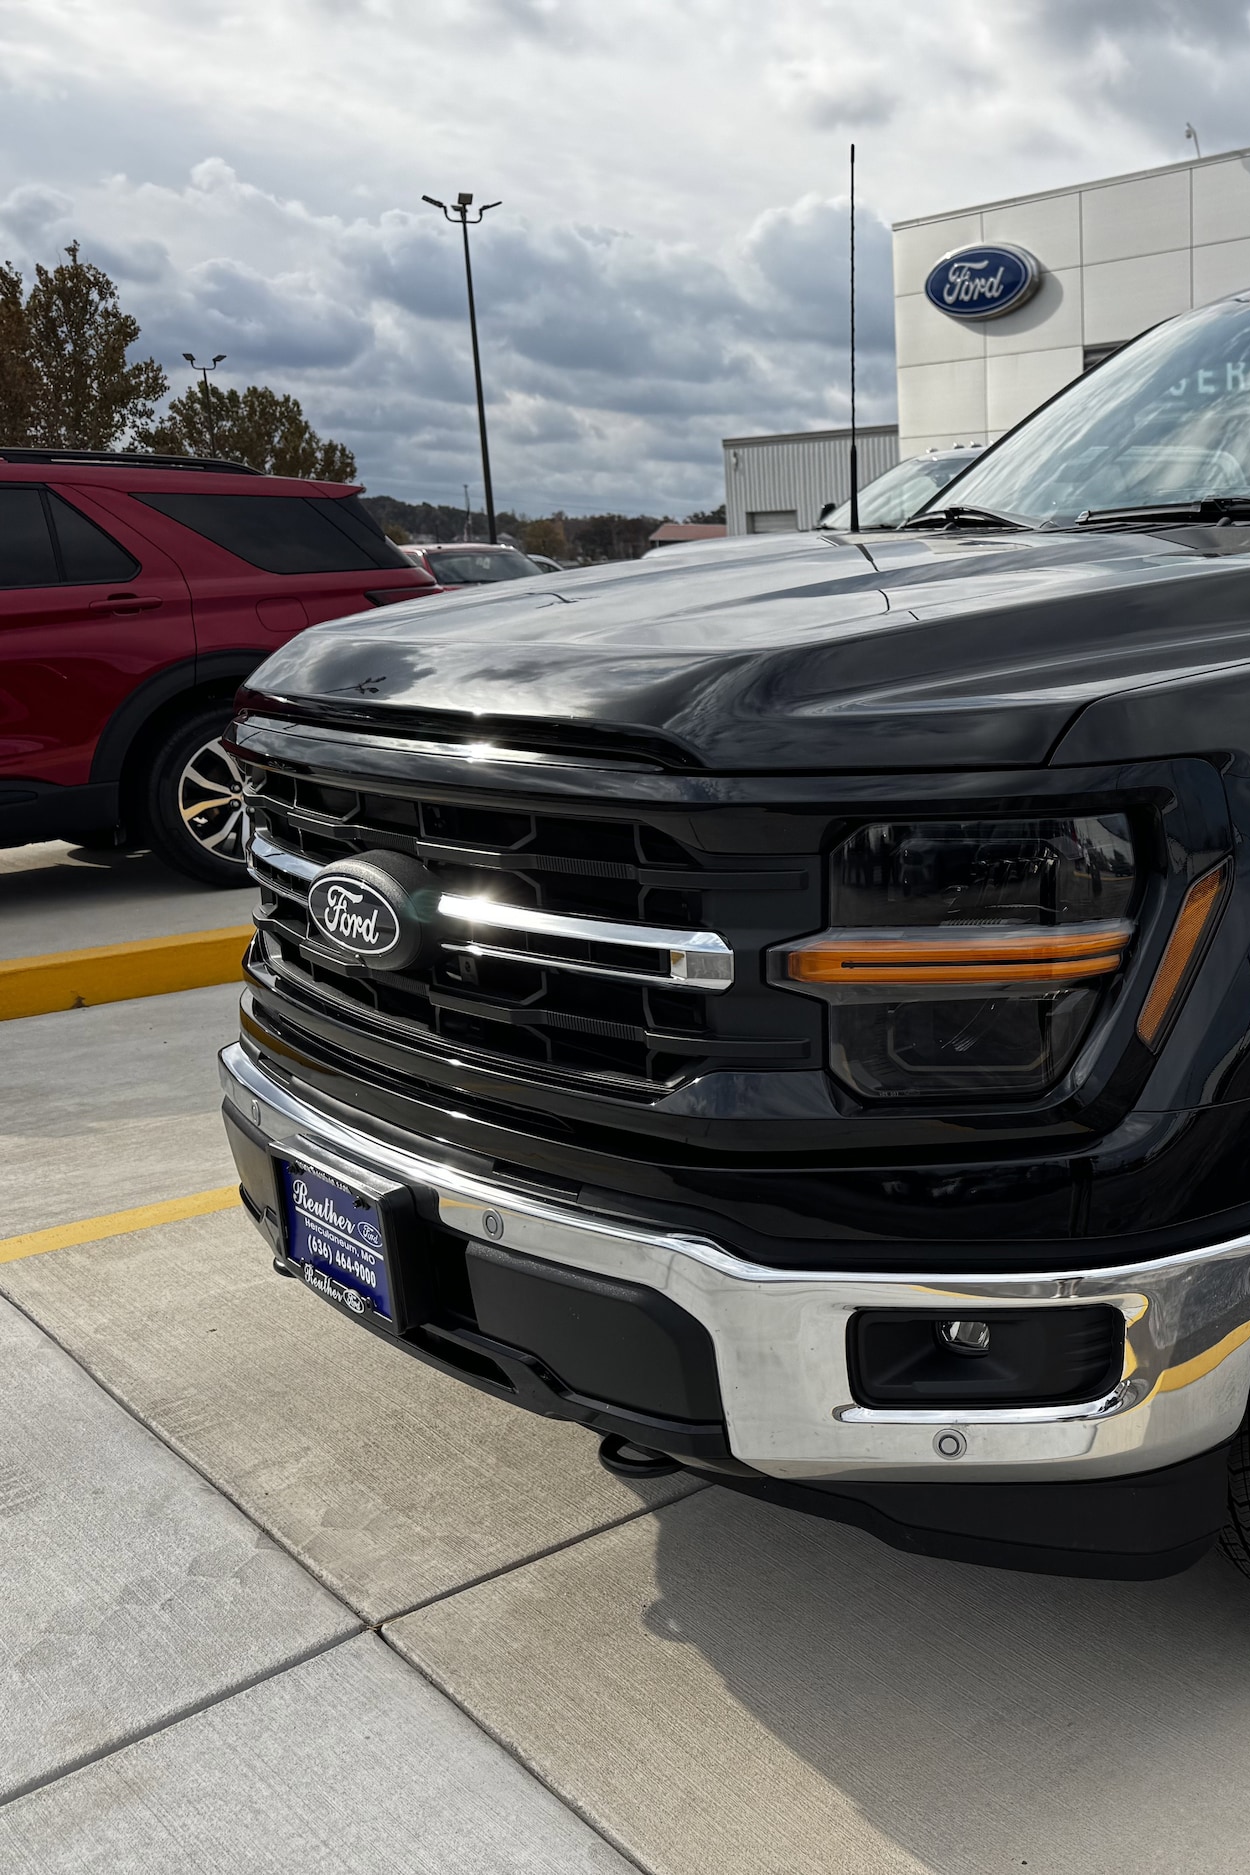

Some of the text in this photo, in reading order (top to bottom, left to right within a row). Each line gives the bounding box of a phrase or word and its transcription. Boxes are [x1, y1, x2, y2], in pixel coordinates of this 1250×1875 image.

[943, 260, 1004, 304] Ford
[324, 885, 379, 944] Ford
[293, 1179, 355, 1234] Reuther
[305, 1217, 376, 1265] Herculaneum, MO
[308, 1233, 376, 1289] (636) 464-9000
[304, 1262, 343, 1302] Reuther
